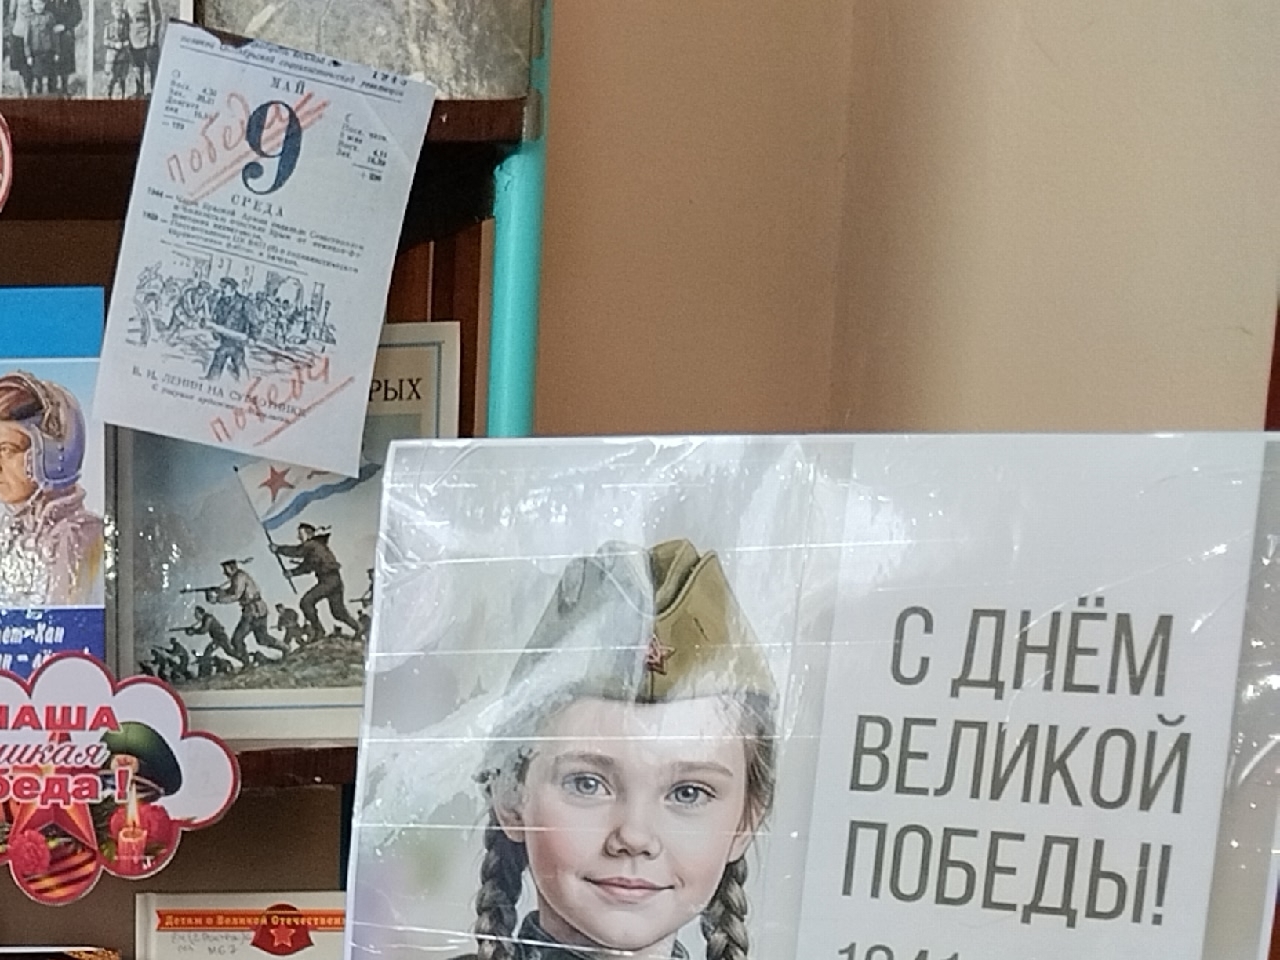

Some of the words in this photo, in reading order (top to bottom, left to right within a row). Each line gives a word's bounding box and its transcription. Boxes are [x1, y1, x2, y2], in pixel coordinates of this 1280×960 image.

[270, 77, 305, 96] МАЙ
[242, 101, 302, 195] 9
[230, 194, 285, 218] СРЕДА
[208, 385, 224, 398] НА
[368, 378, 423, 402] РЫХ
[890, 605, 934, 686] С
[950, 597, 1174, 700] ДНЁМ
[849, 713, 1192, 814] ВЕЛИКОЙ
[841, 819, 1173, 929] ПОБЕДЫ!
[164, 915, 203, 927] Детям
[216, 914, 268, 926] Великой
